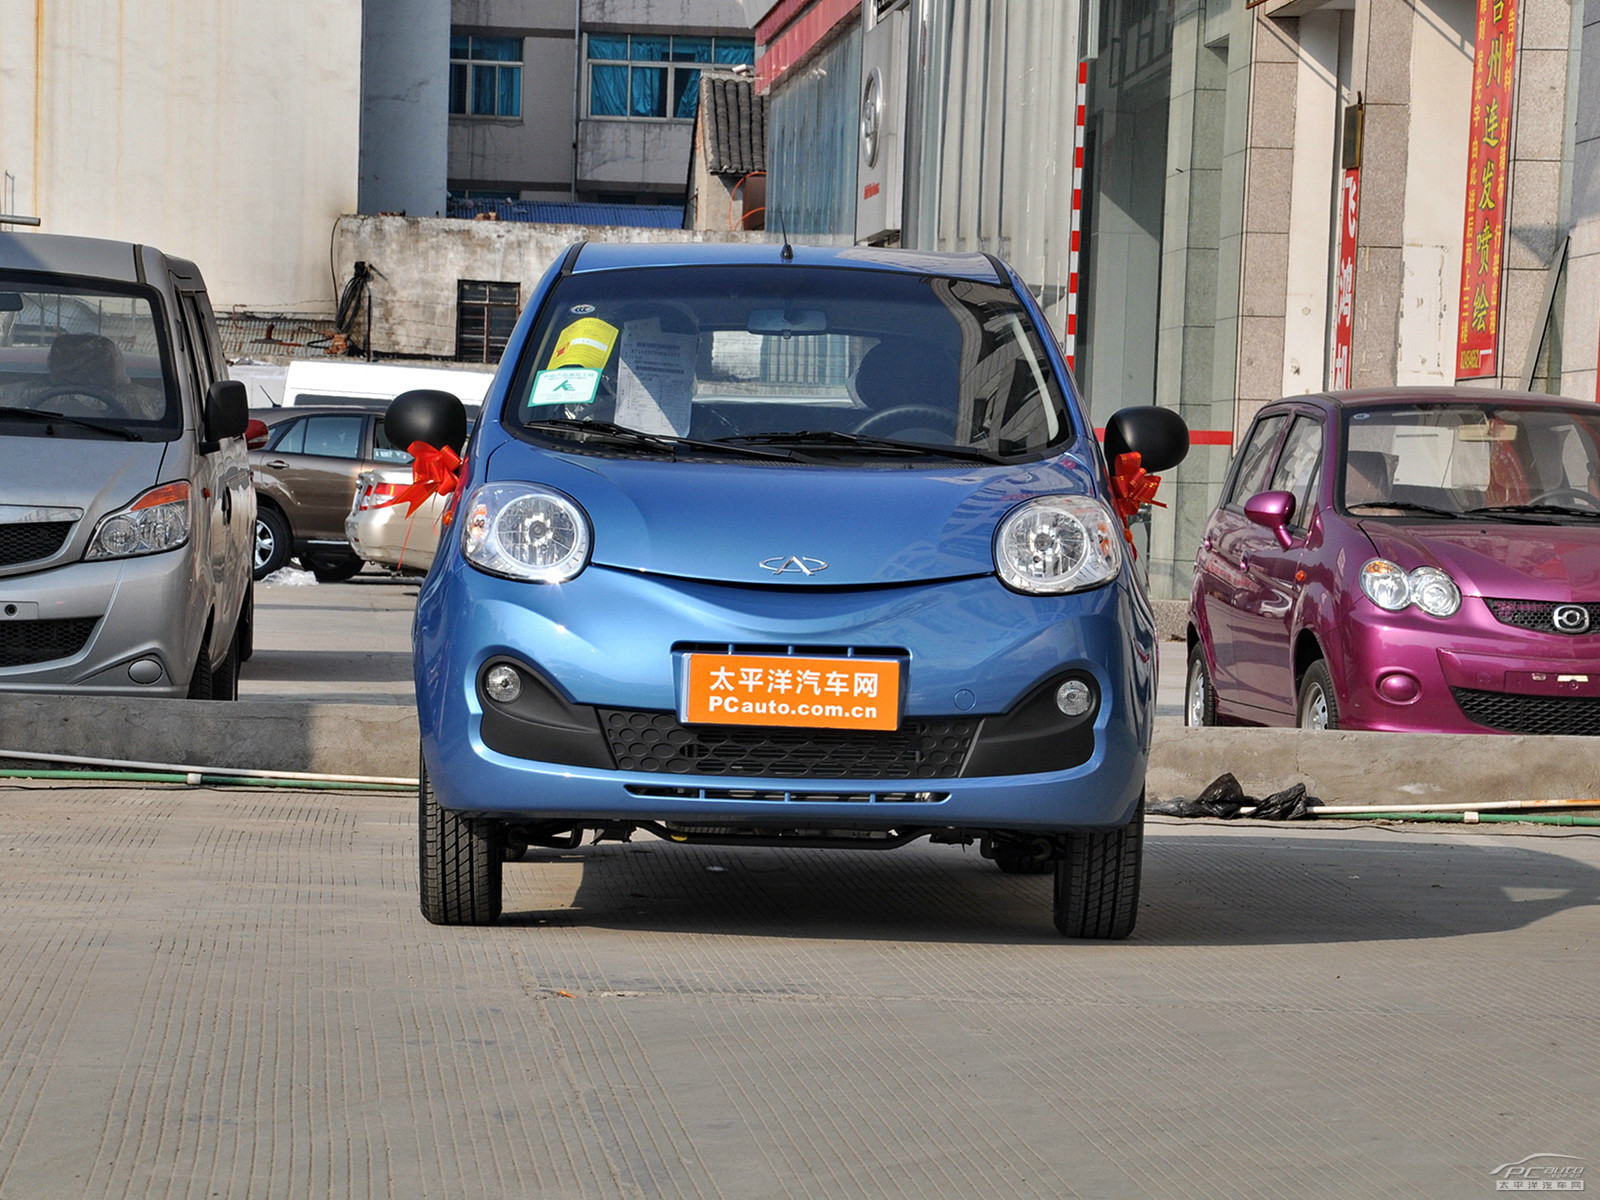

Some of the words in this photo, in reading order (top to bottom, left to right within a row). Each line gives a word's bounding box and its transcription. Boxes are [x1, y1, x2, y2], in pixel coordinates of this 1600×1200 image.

[708, 665, 879, 698] 太平洋汽车网
[708, 695, 878, 719] PCauto.com.cn
